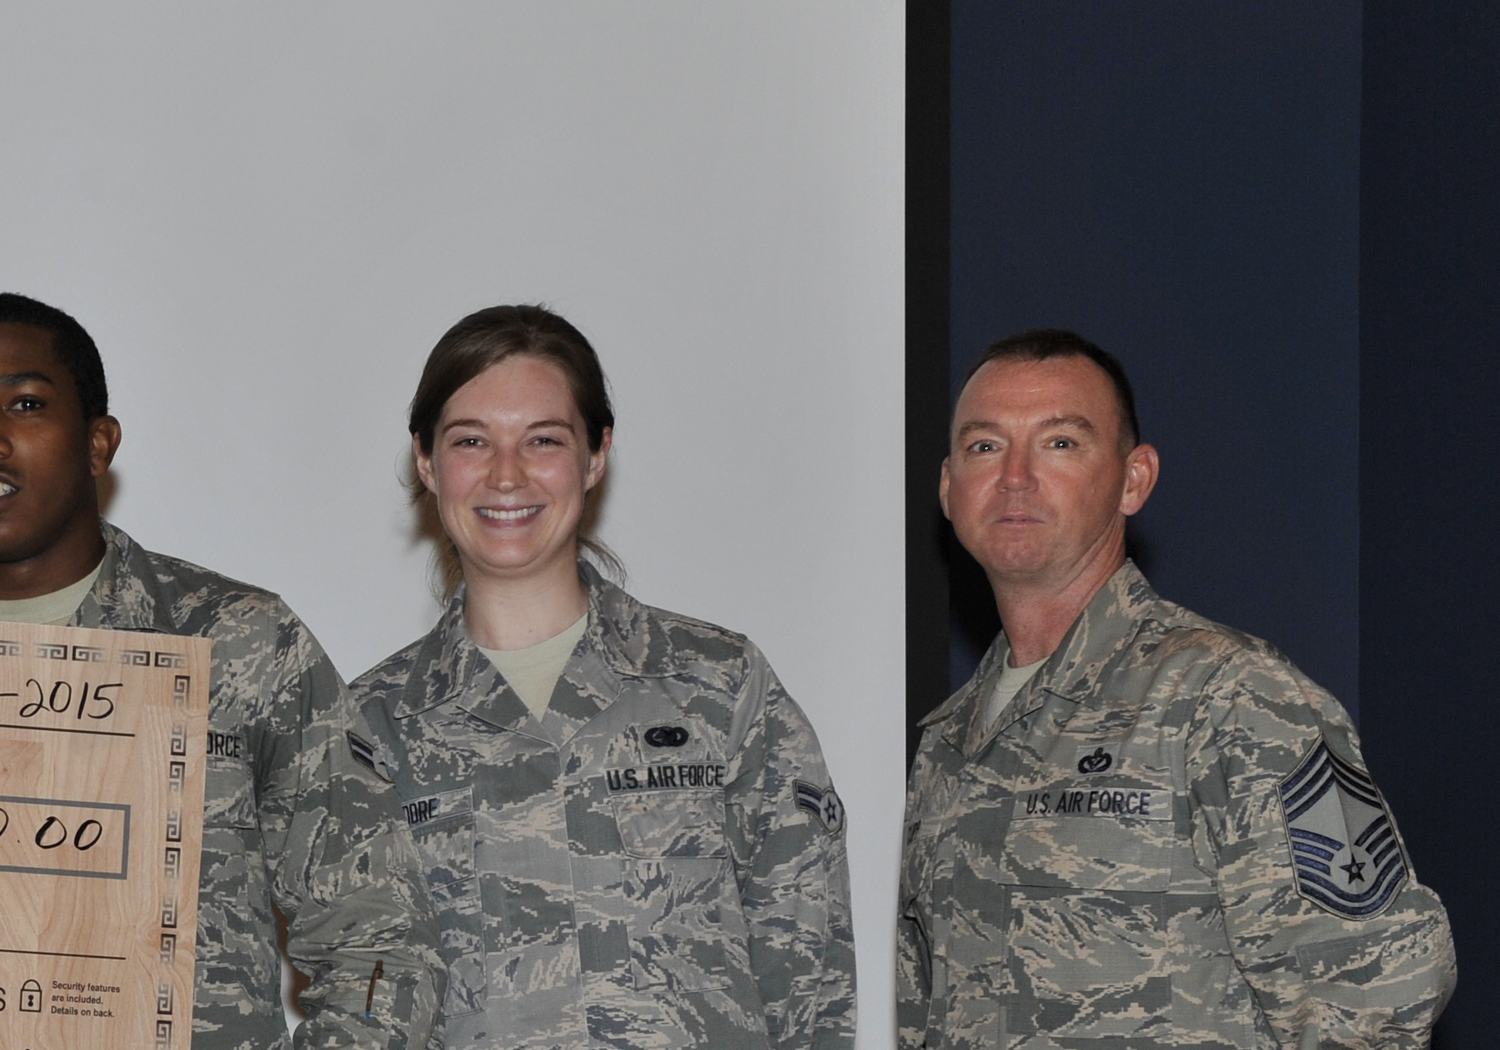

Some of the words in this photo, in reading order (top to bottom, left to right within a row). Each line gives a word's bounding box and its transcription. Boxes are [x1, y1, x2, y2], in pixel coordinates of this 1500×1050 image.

[606, 768, 643, 791] U.S.
[647, 765, 677, 788] AIR
[678, 764, 725, 788] FORCE
[1026, 792, 1051, 815] U.S.
[1054, 790, 1084, 814] AIR
[1087, 790, 1151, 816] FORCE
[52, 980, 86, 992] Security
[87, 983, 121, 993] features
[51, 994, 65, 1002] are
[66, 994, 104, 1005] included.
[51, 1005, 79, 1016] Details
[93, 1008, 115, 1018] back.
